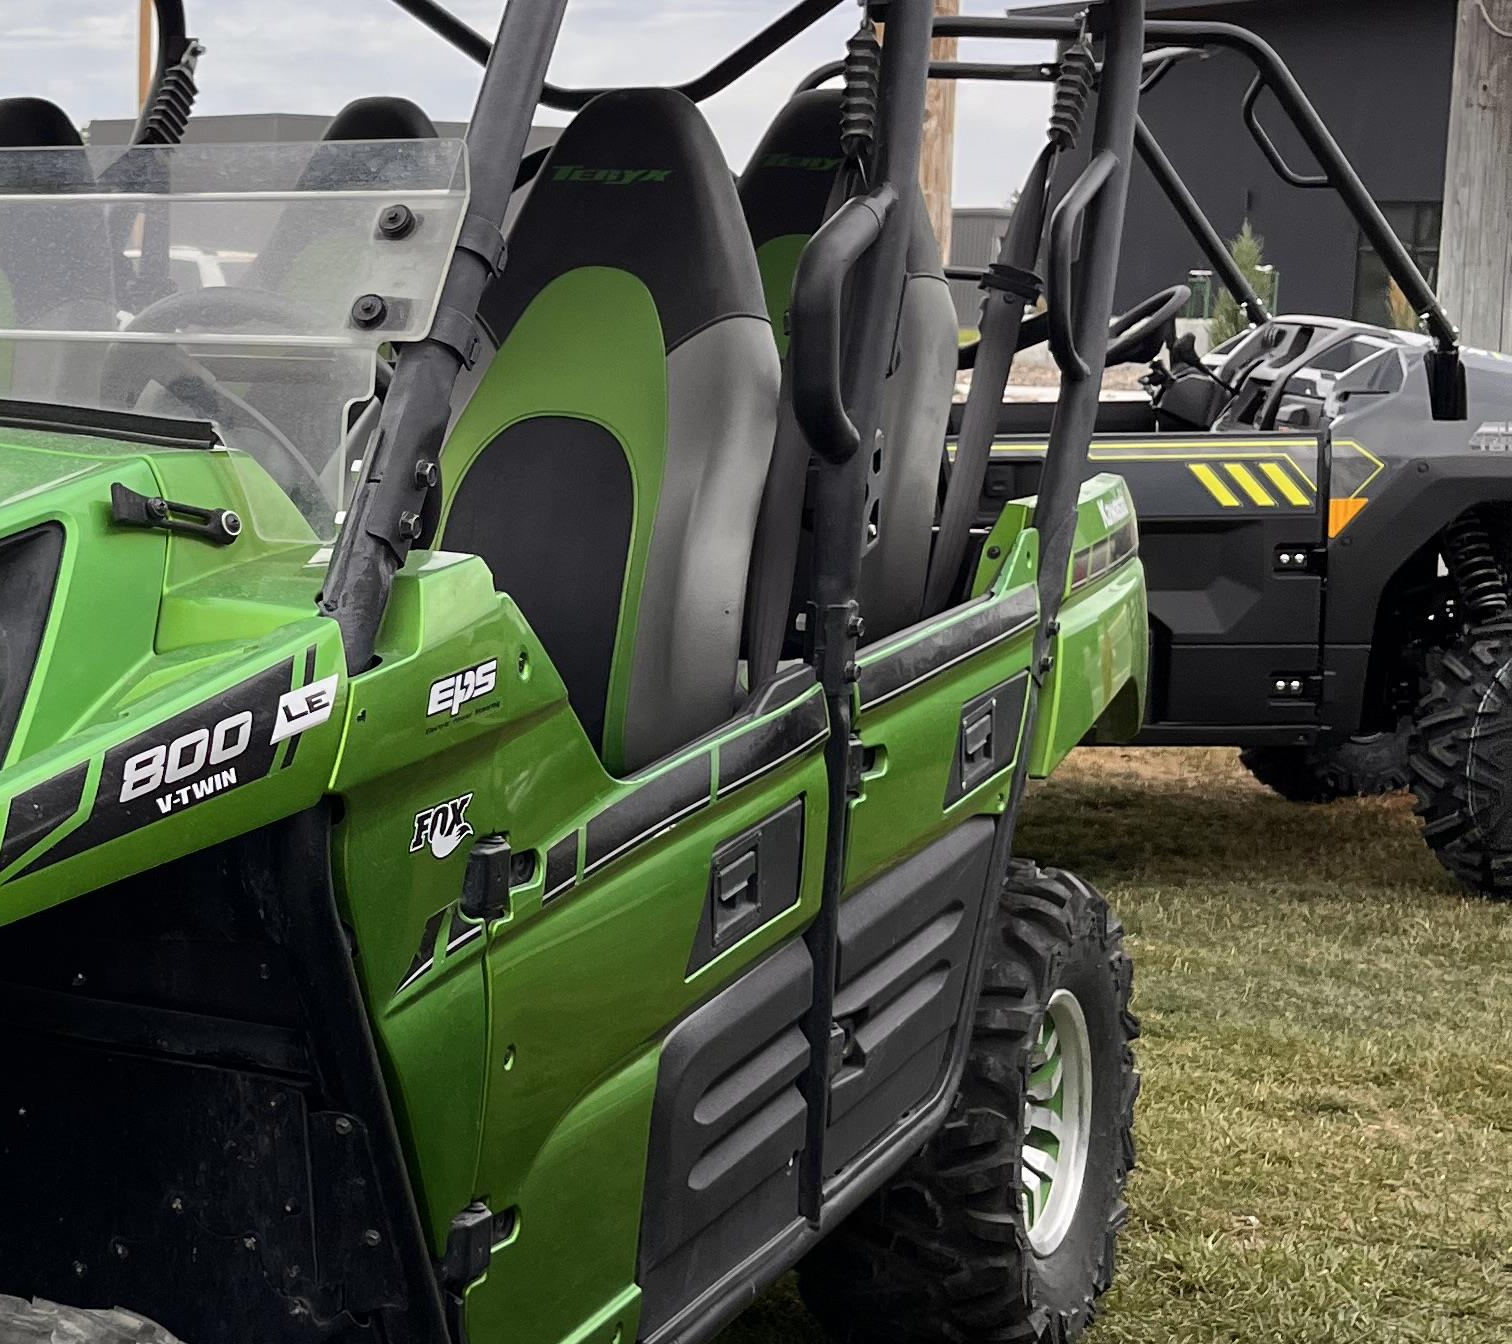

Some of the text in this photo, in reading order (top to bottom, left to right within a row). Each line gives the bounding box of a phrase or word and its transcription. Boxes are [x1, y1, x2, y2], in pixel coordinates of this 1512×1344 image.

[283, 689, 331, 723] LE
[426, 658, 498, 717] EPS
[119, 710, 254, 804] 800
[155, 767, 238, 815] V-TWIN
[409, 792, 474, 854] FOX
